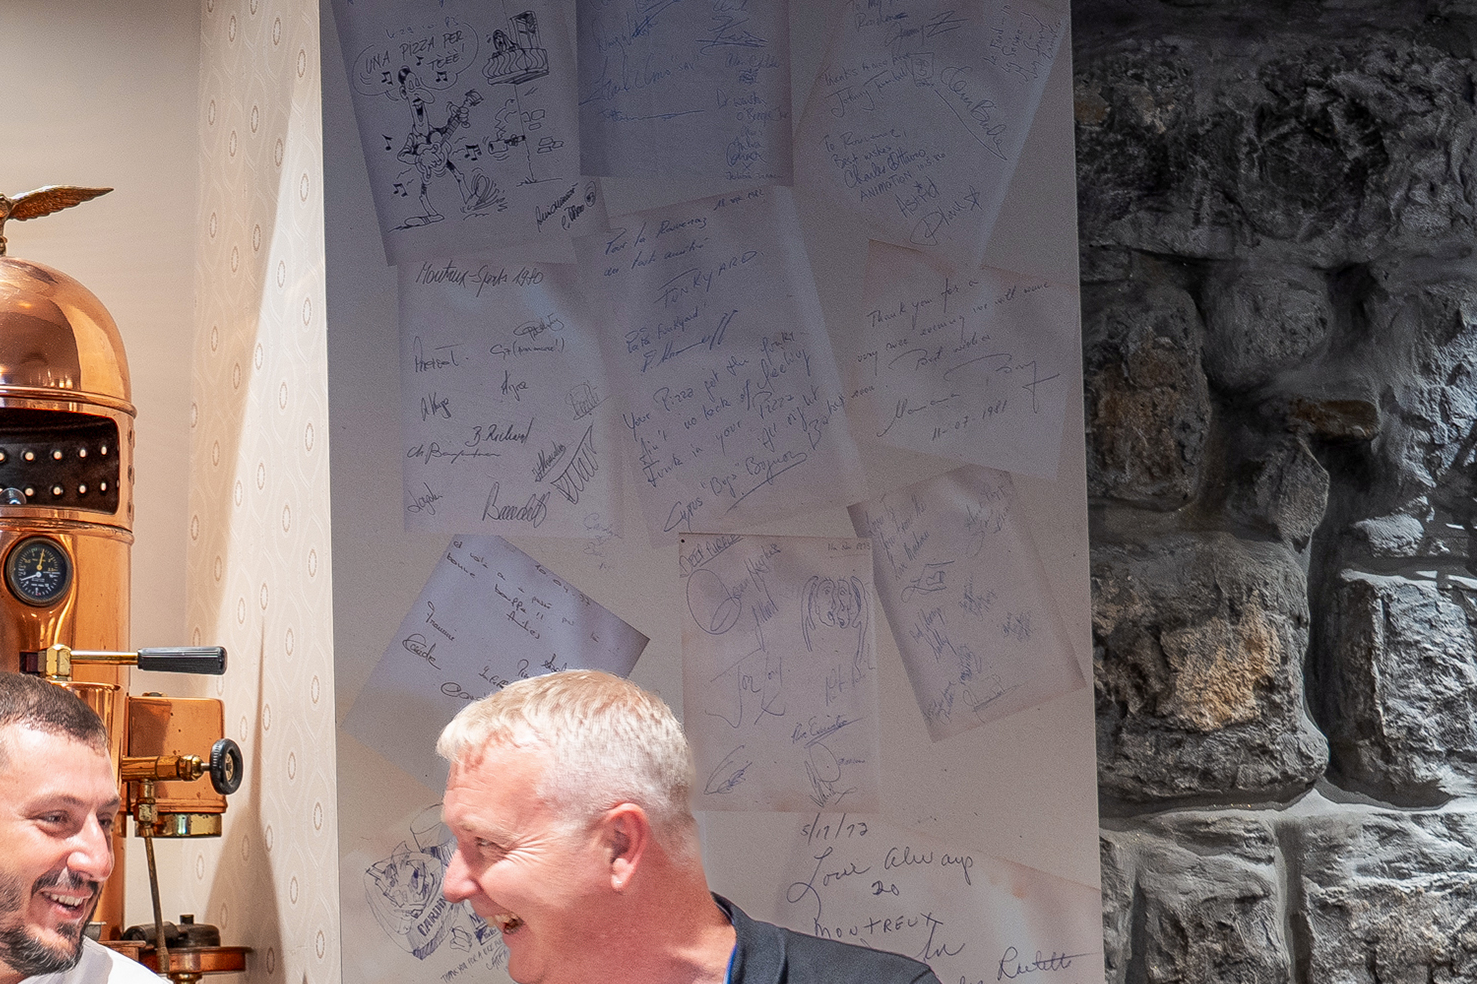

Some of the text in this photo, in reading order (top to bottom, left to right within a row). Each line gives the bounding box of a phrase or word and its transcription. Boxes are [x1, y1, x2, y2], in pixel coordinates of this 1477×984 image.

[365, 30, 463, 74] UNA PIZZA PER
[859, 170, 914, 202] ANIMOTION
[866, 301, 907, 328] Thank
[911, 298, 933, 331] you
[940, 277, 959, 314] for
[622, 411, 651, 442] Your
[653, 386, 695, 411] Pizza
[715, 420, 743, 456] your
